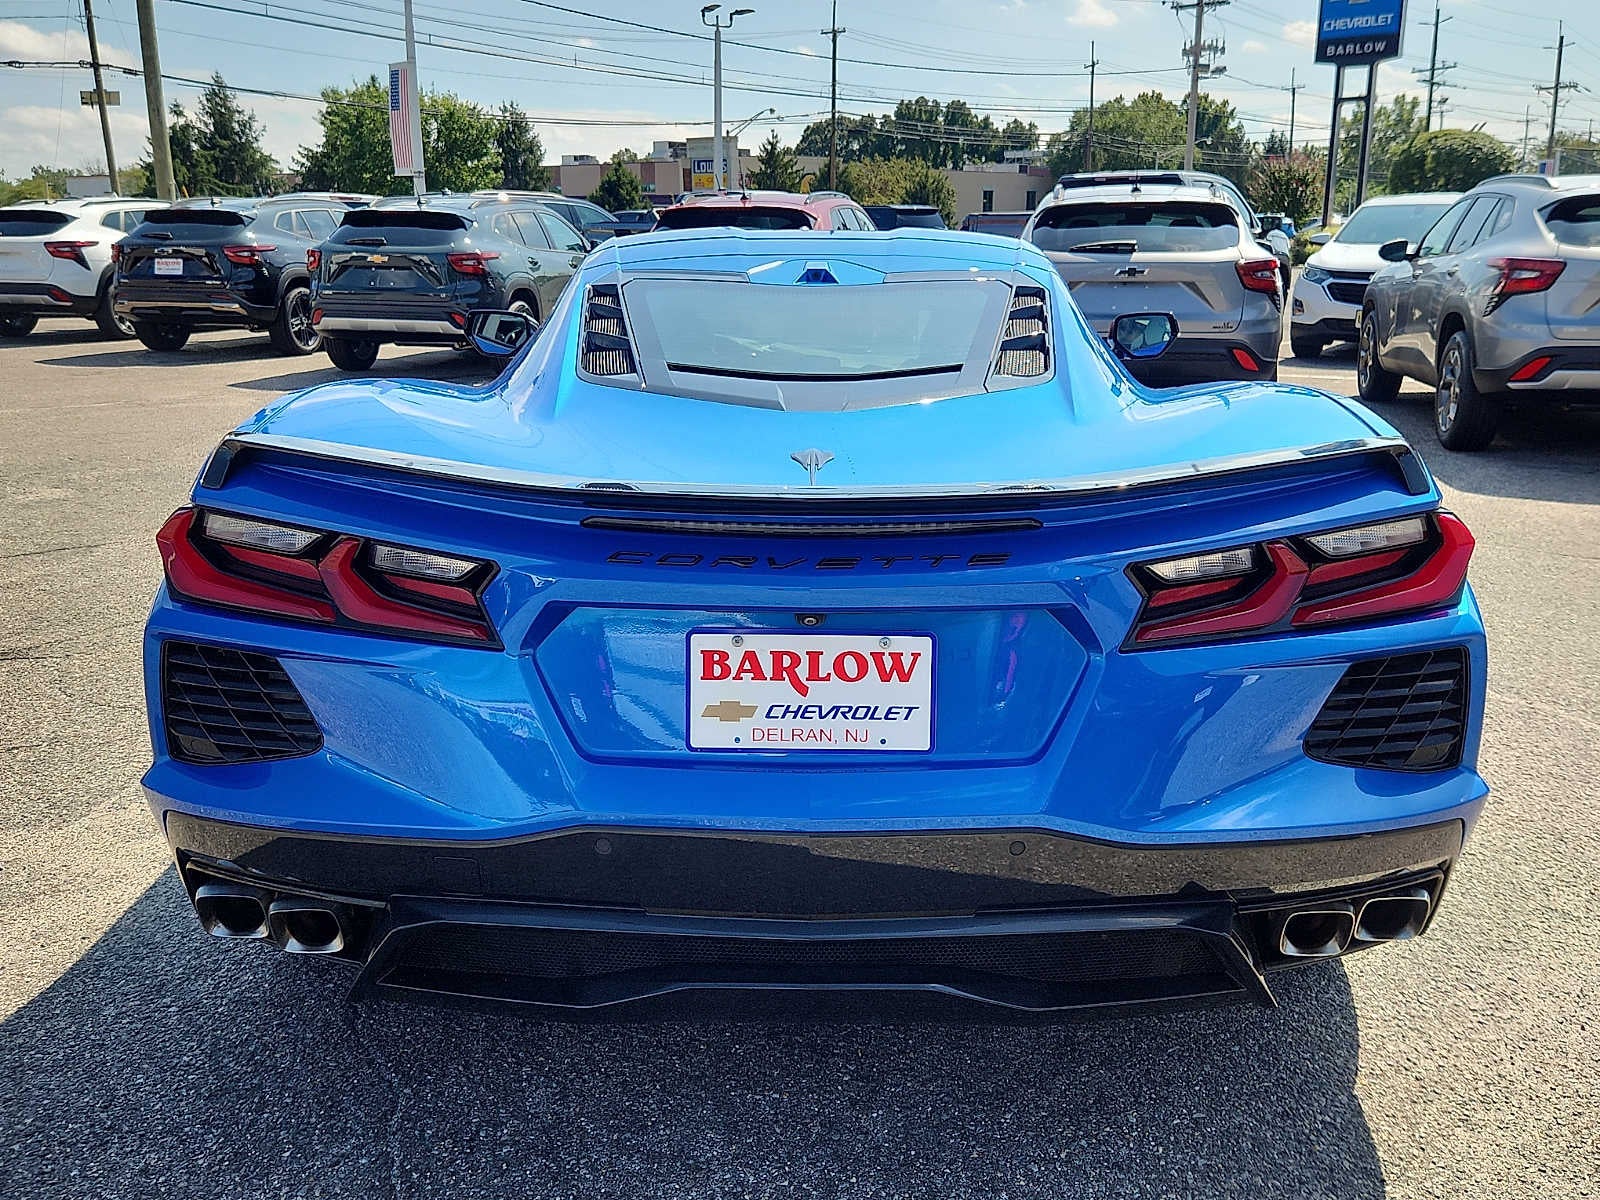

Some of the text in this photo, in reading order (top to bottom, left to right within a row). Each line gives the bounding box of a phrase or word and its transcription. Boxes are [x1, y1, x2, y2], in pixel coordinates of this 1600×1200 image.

[1323, 13, 1394, 31] CHEVROLET
[1326, 41, 1387, 57] BARLOW
[607, 551, 1011, 568] CORVETTE
[700, 649, 922, 698] BARLOW
[765, 704, 920, 721] CHEVROLET
[752, 728, 869, 744] DELRAN, NJ
